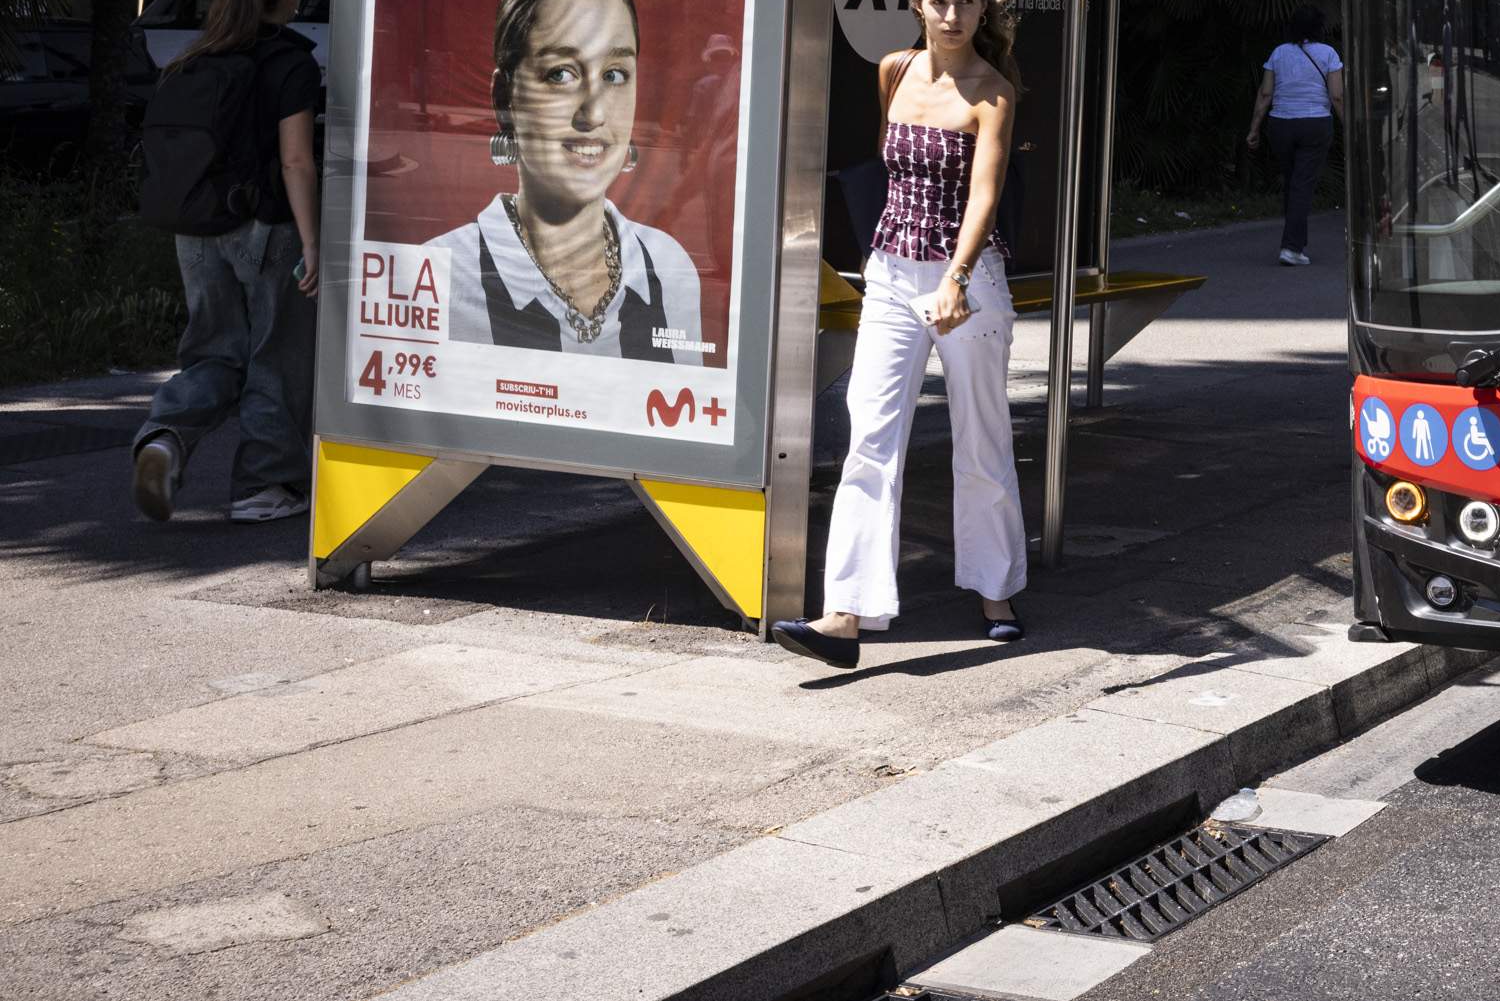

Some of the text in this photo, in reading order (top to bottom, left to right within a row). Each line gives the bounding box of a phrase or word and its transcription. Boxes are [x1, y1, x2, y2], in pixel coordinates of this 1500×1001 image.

[362, 252, 439, 304] PLA
[360, 301, 440, 331] LLIURE
[652, 327, 686, 340] LAURA
[394, 382, 421, 400] MES
[500, 382, 554, 397] SUBSCRIU-T'HI
[496, 400, 588, 419] movistarplus.es
